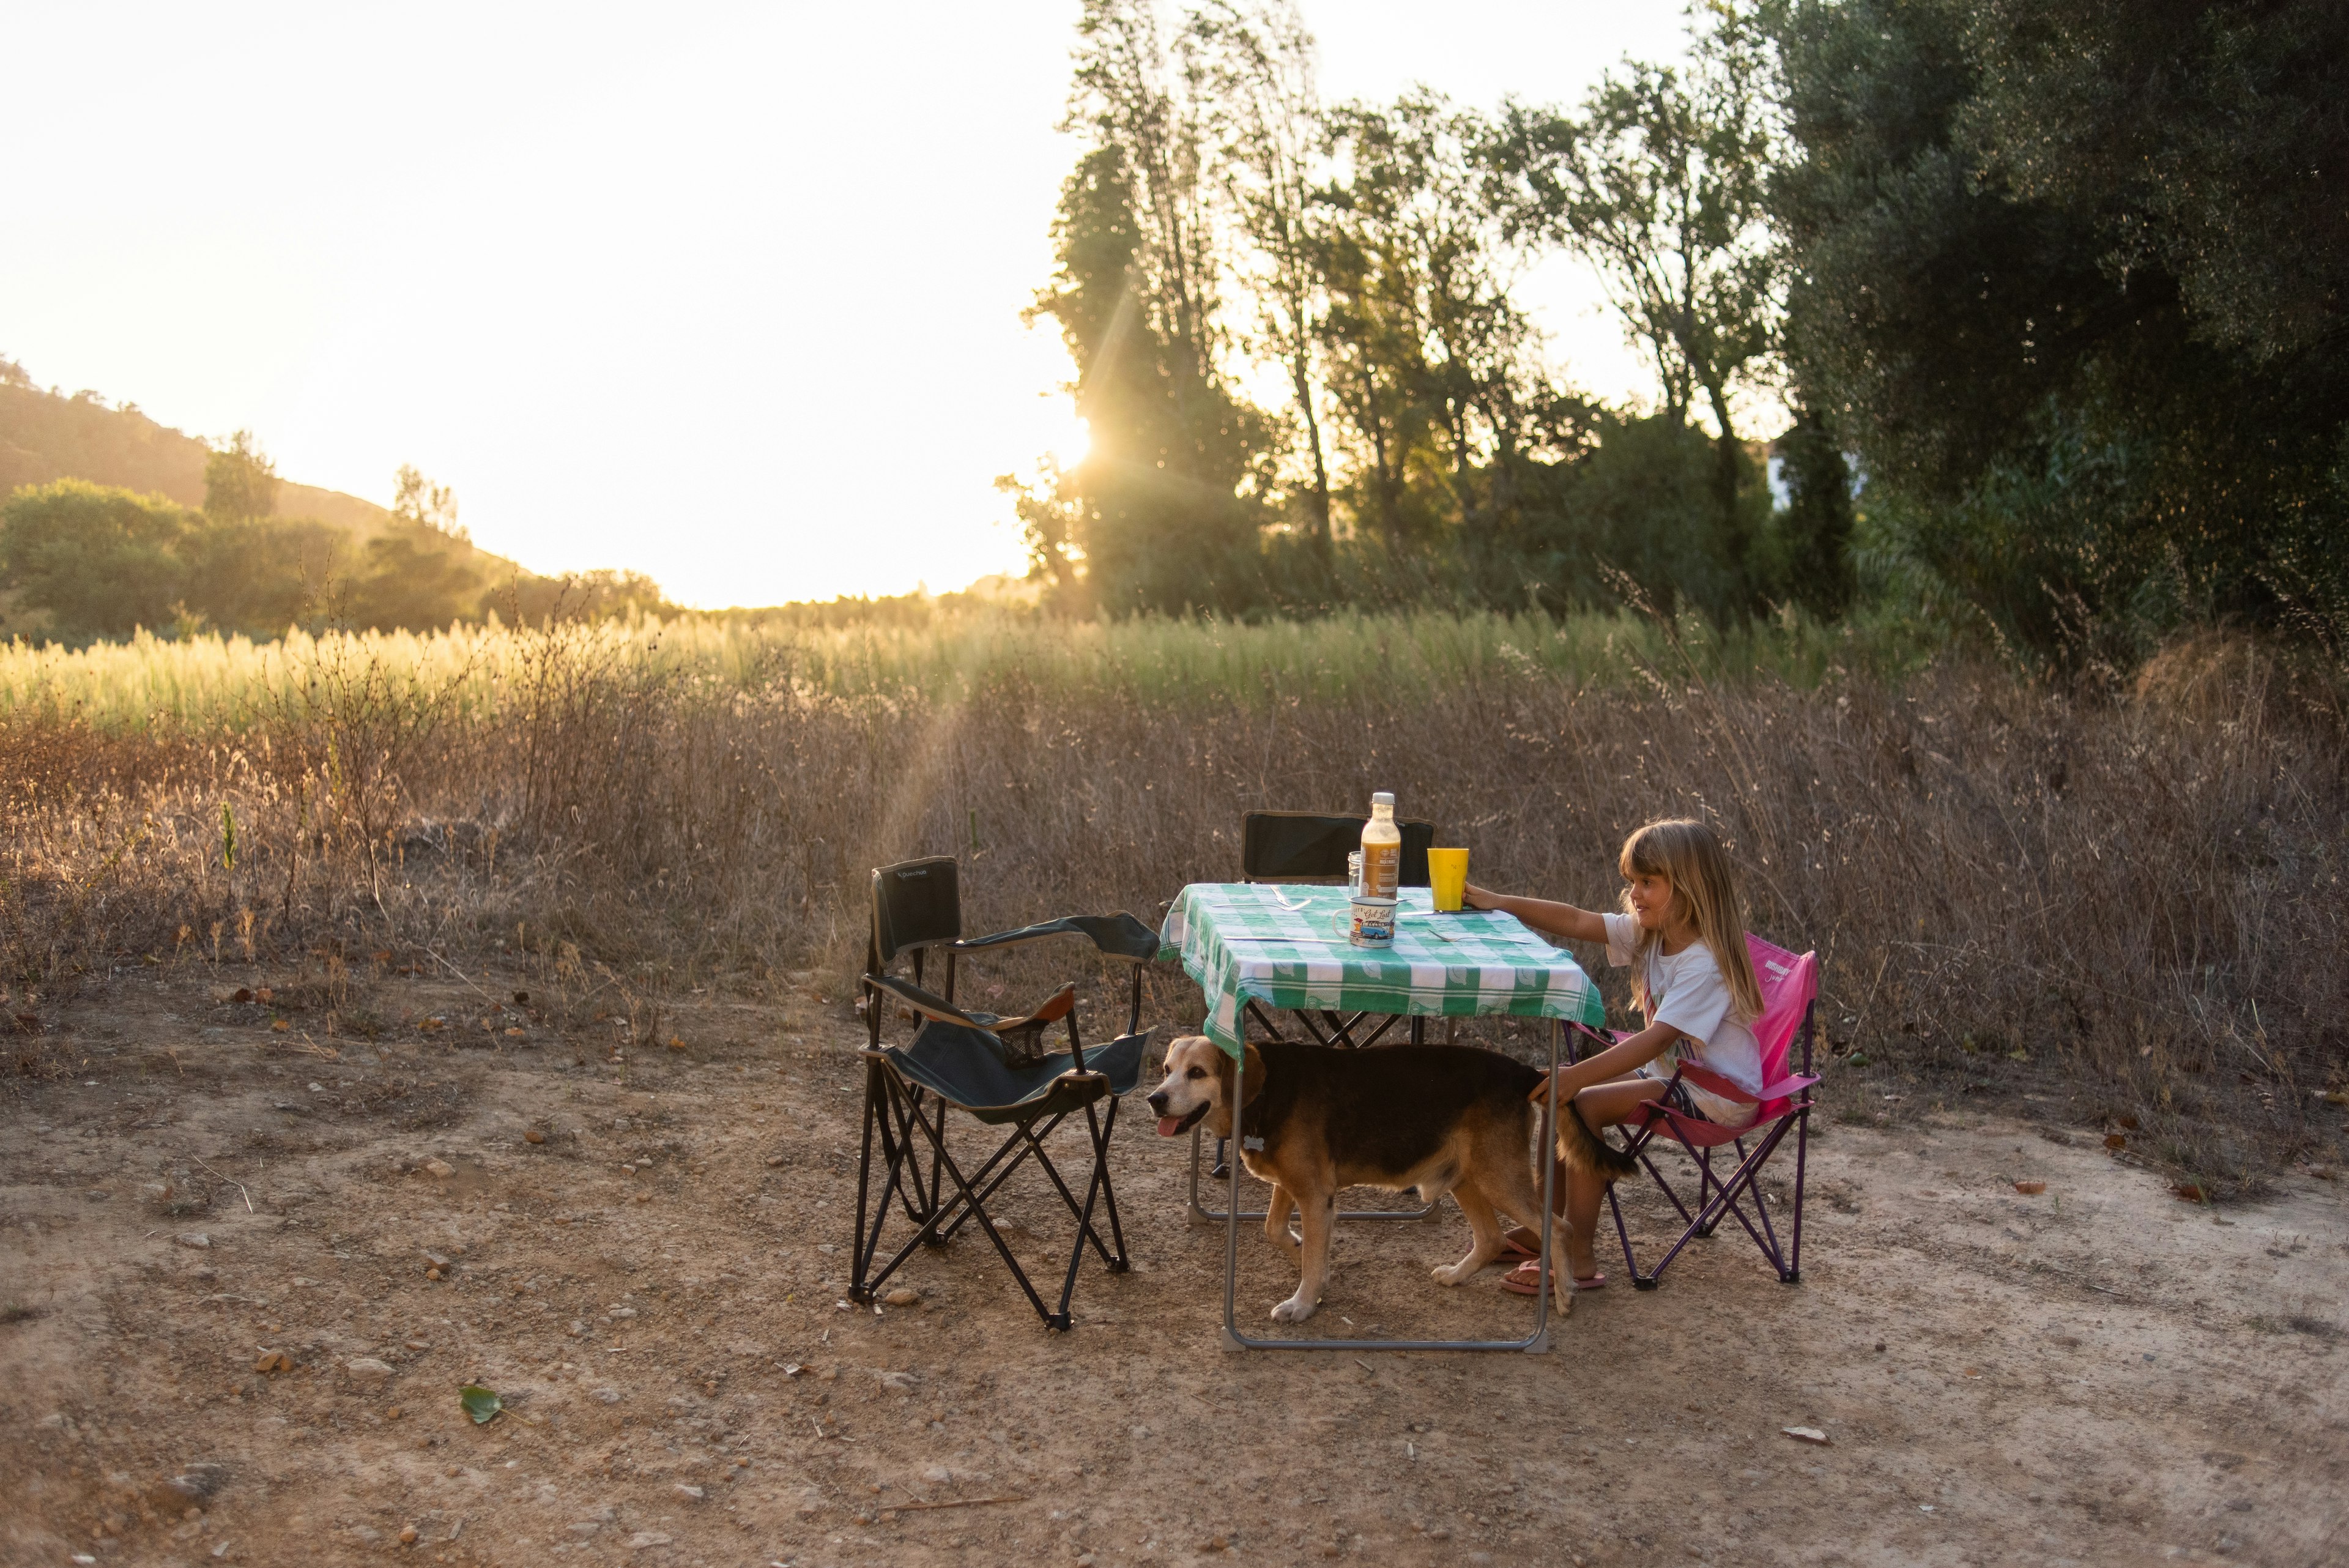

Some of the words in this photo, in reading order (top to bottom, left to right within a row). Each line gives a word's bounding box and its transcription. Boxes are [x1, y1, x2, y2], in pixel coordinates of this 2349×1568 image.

[1364, 909, 1378, 920] Get
[1377, 909, 1391, 920] Lost
[1765, 960, 1791, 976] BUSHBAY
